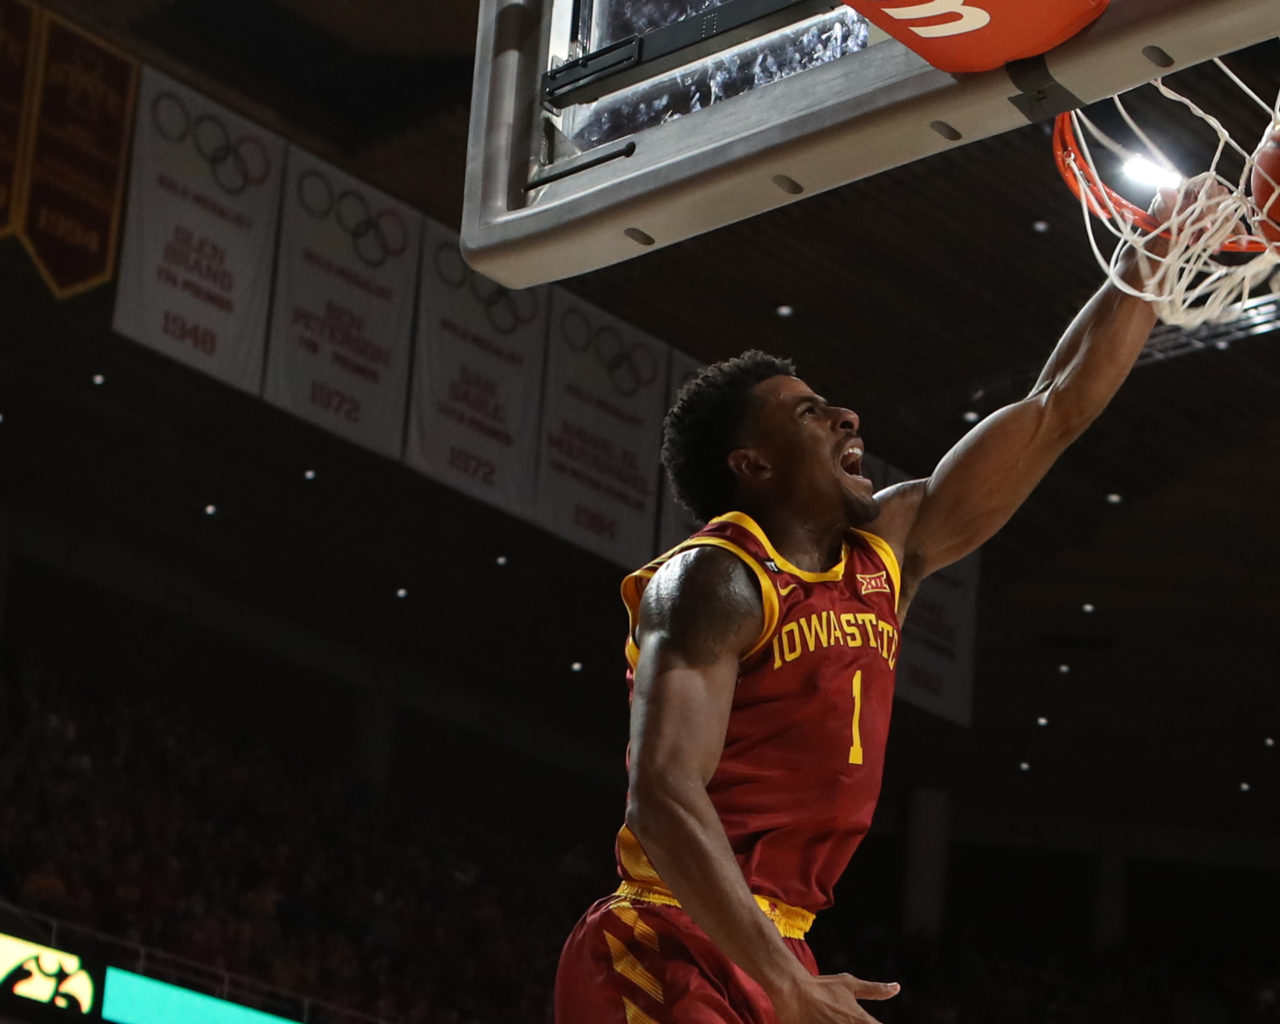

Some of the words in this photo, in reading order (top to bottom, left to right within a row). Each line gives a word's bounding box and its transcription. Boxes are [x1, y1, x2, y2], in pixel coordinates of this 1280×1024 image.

[773, 610, 844, 670] IOWA
[840, 612, 898, 671] STT
[848, 669, 863, 765] 1
